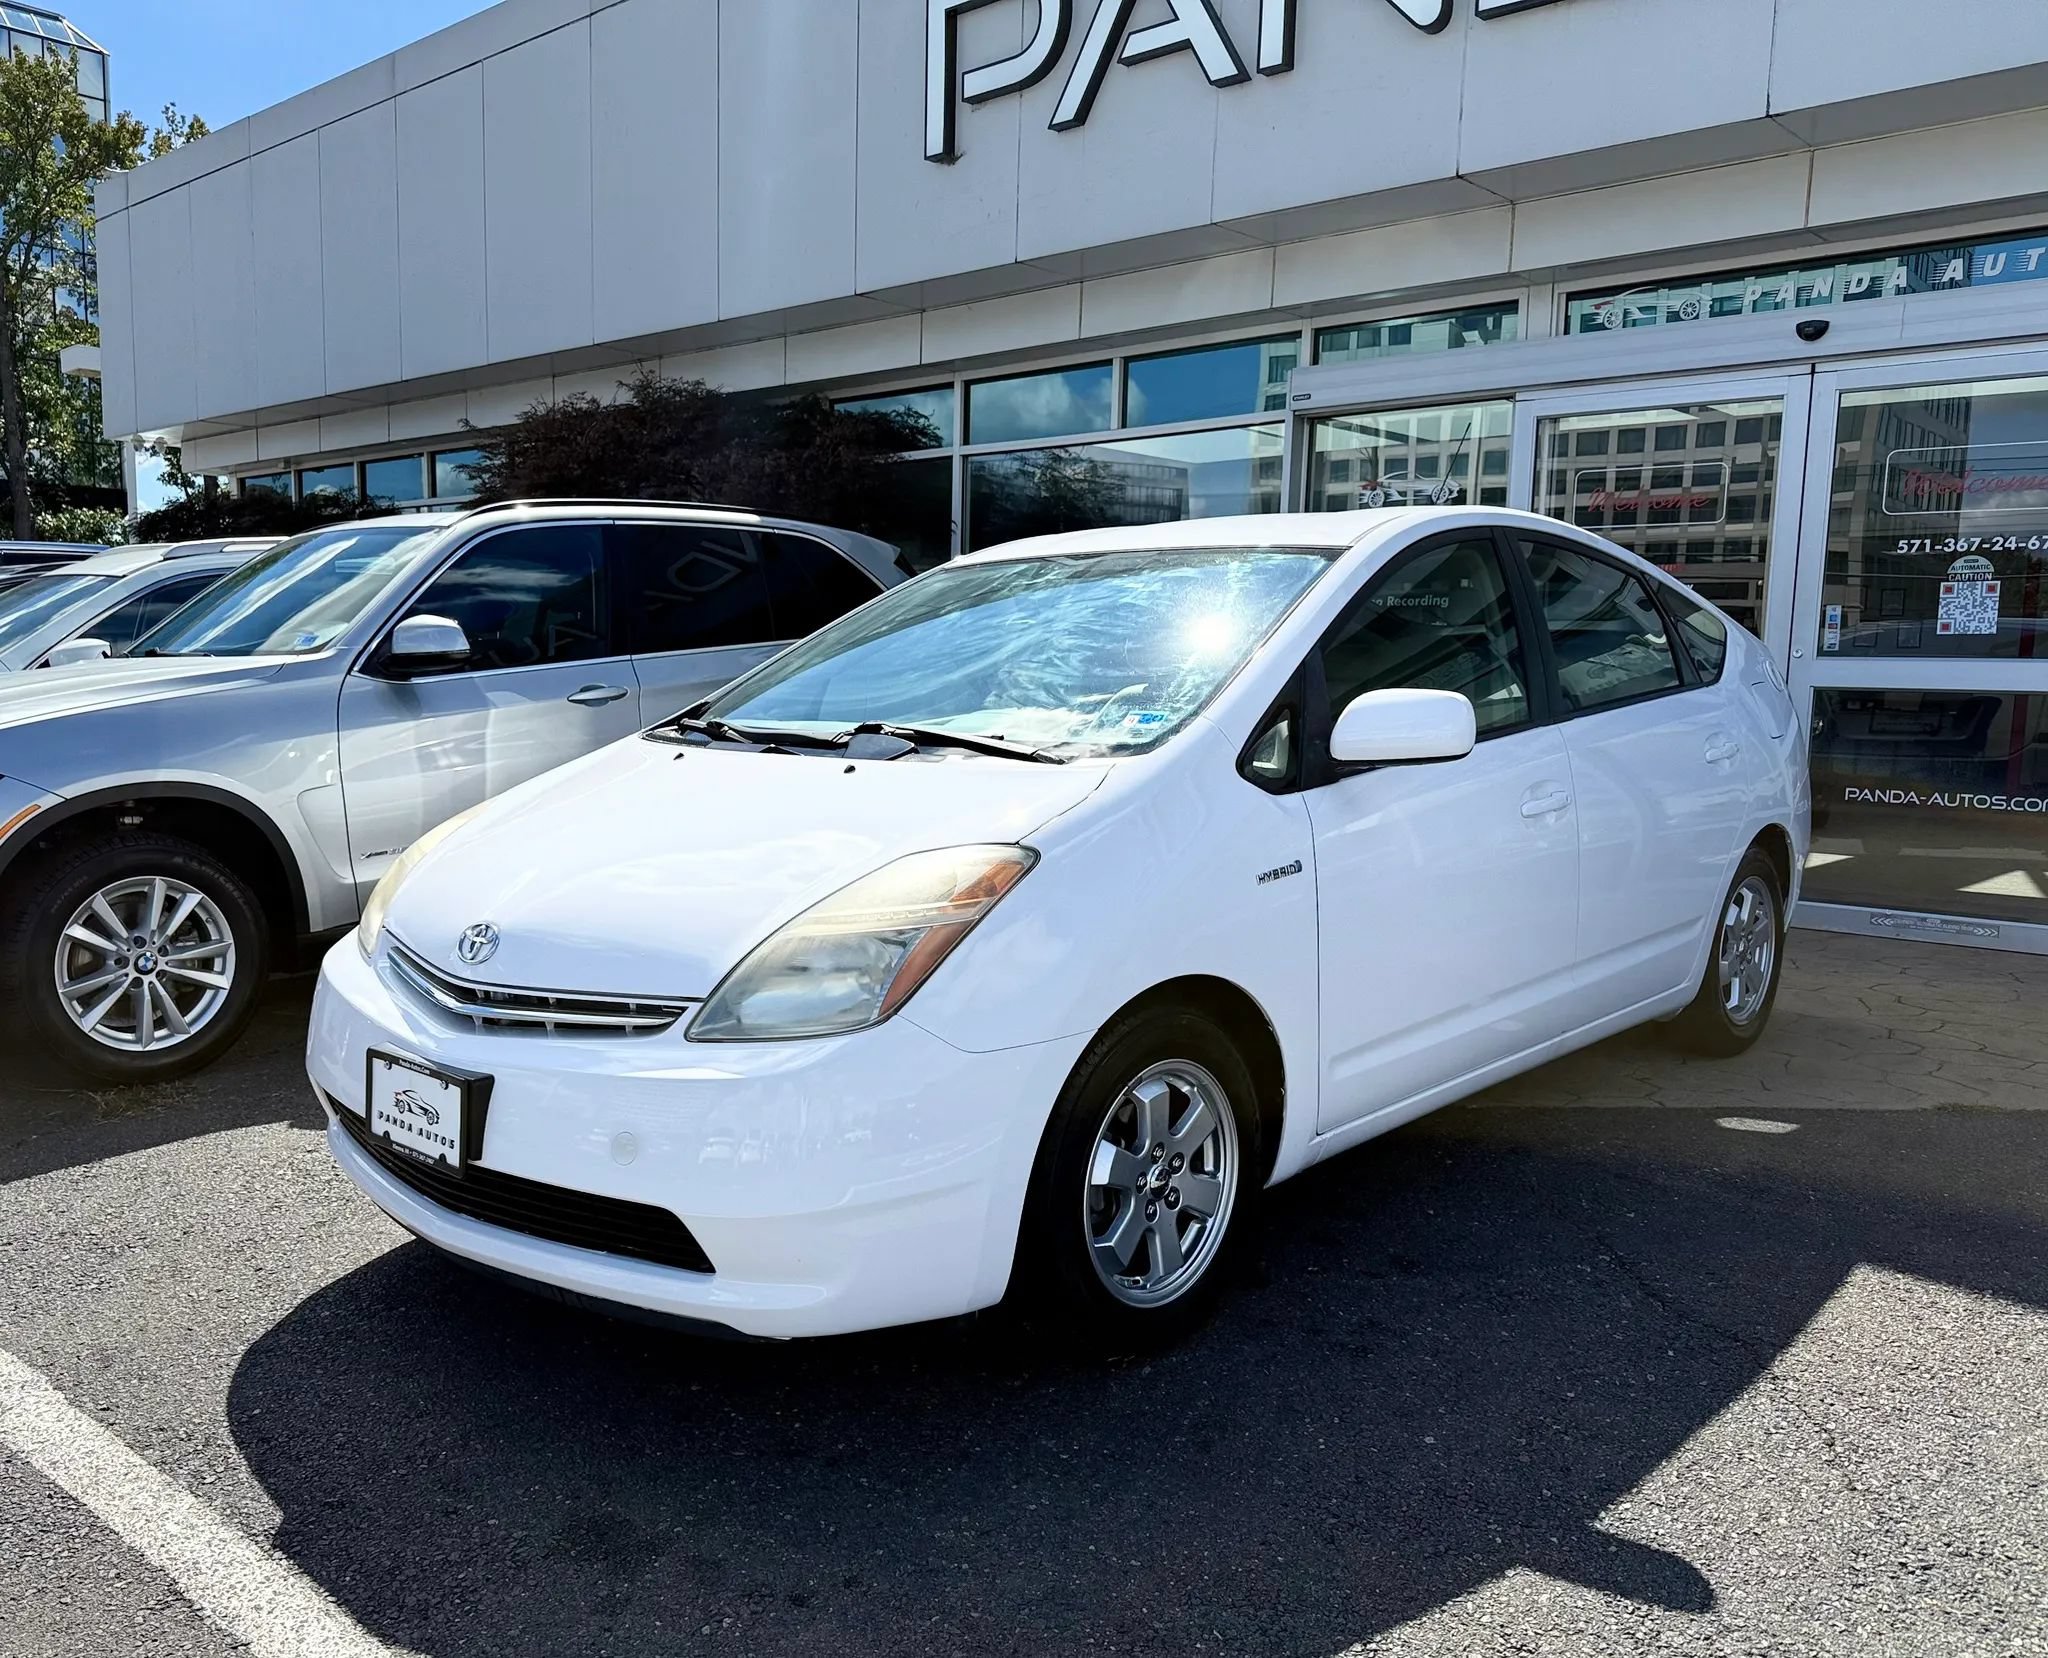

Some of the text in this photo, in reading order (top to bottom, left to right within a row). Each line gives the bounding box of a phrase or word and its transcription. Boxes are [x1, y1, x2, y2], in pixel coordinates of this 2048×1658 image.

[1740, 266, 1907, 305] PANDA
[1588, 484, 1710, 512] Welcome
[1948, 572, 1992, 581] CAUTION
[1950, 564, 1991, 572] AUTOMATIC
[1387, 595, 1449, 608] Recording
[1844, 786, 2048, 812] PANDA-AUTOS.CO
[1256, 862, 1300, 886] HYBRID
[377, 1110, 456, 1150] PANDA AUTOS
